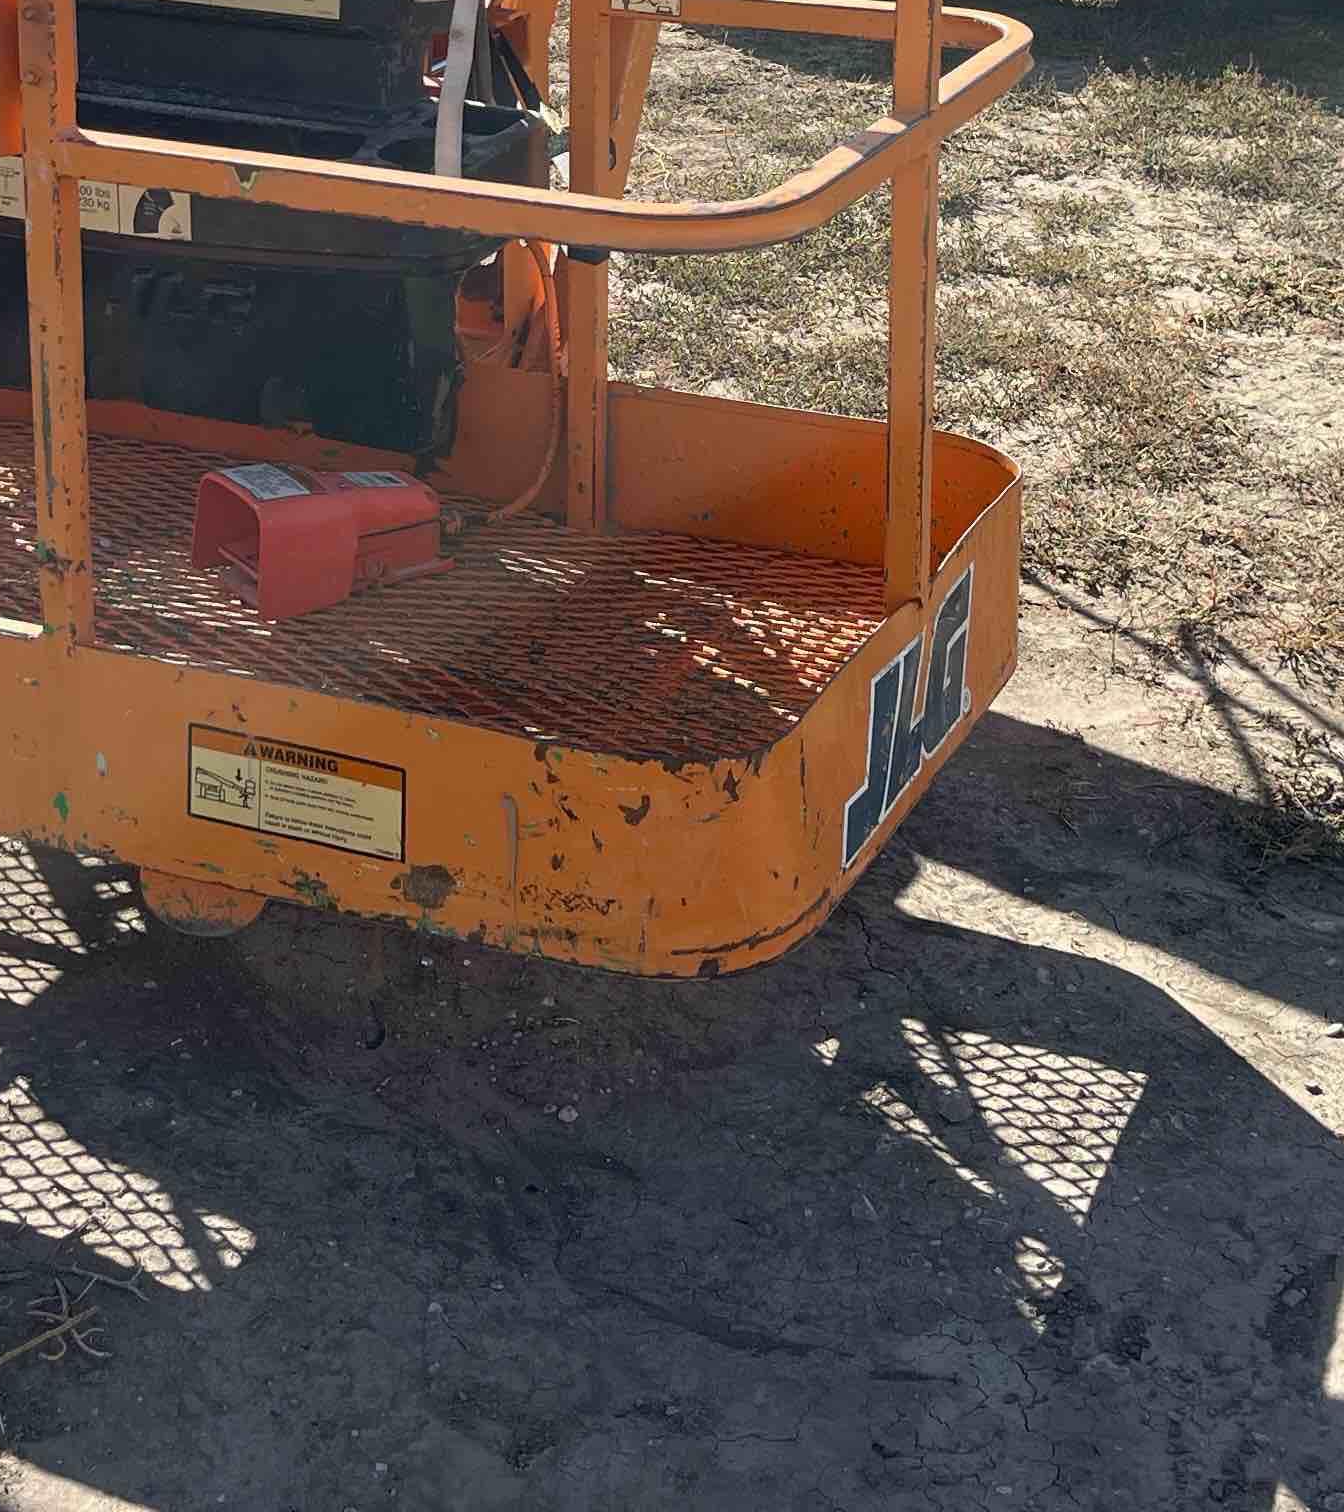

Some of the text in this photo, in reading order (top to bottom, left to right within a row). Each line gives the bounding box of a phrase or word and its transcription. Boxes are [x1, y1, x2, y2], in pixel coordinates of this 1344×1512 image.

[79, 185, 93, 196] 00
[79, 197, 94, 207] 30
[842, 560, 975, 871] JLG
[258, 744, 339, 774] WARNING
